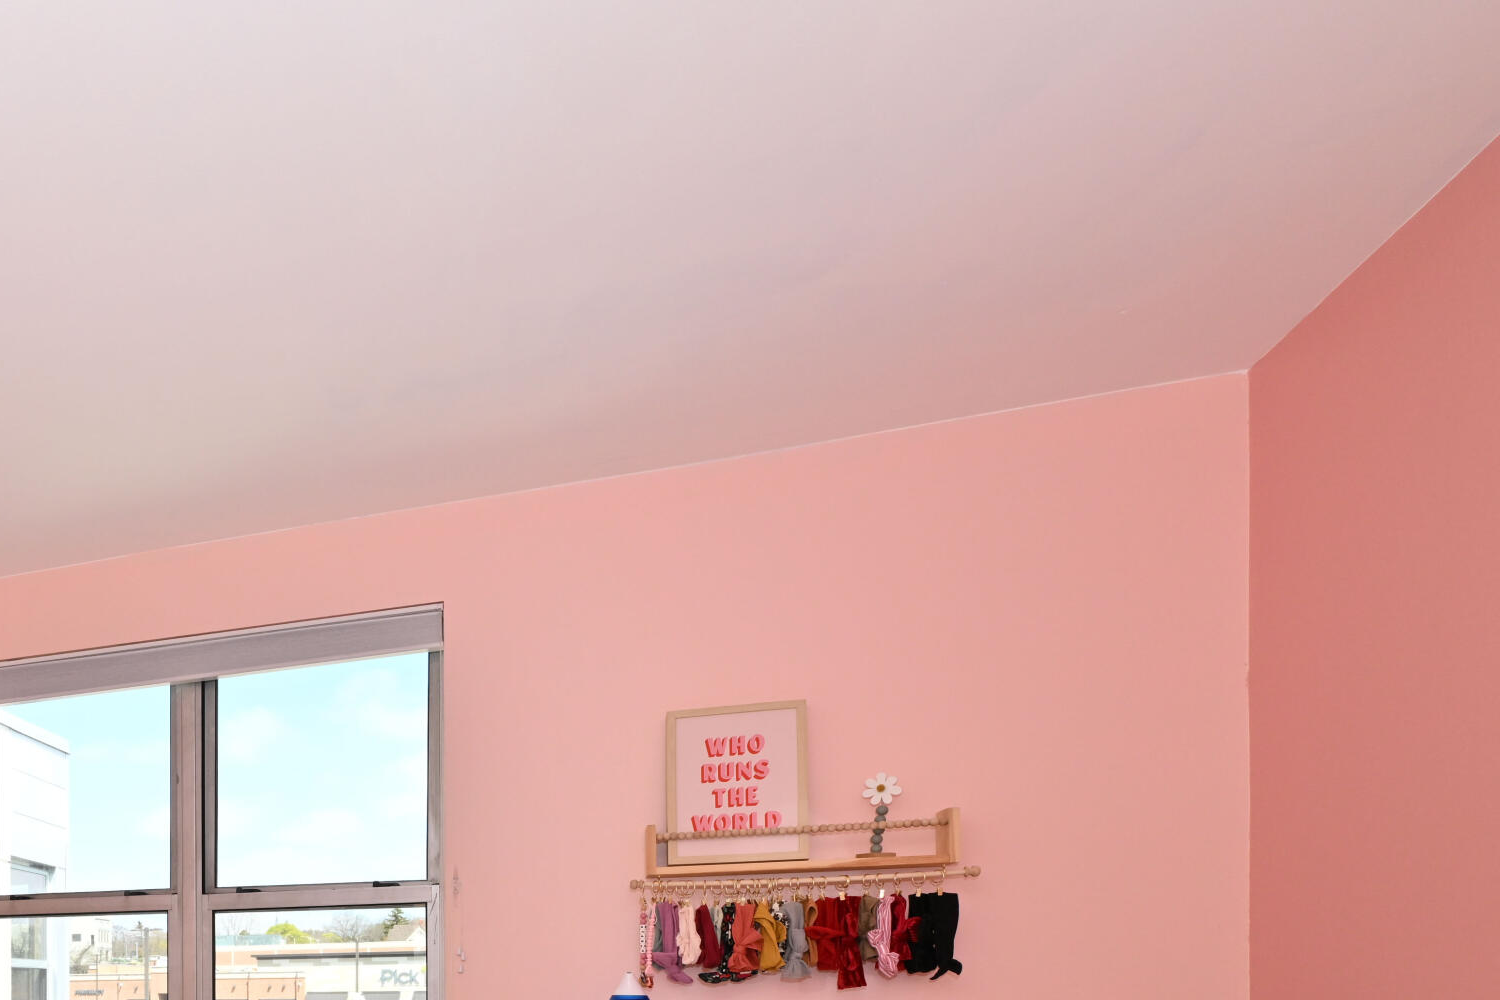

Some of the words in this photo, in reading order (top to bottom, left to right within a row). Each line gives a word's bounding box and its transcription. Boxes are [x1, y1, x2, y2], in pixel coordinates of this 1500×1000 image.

[704, 734, 765, 757] WHO
[700, 759, 770, 783] RUNS
[711, 786, 760, 808] THE
[690, 811, 782, 832] WORLD
[380, 969, 419, 987] Pick
